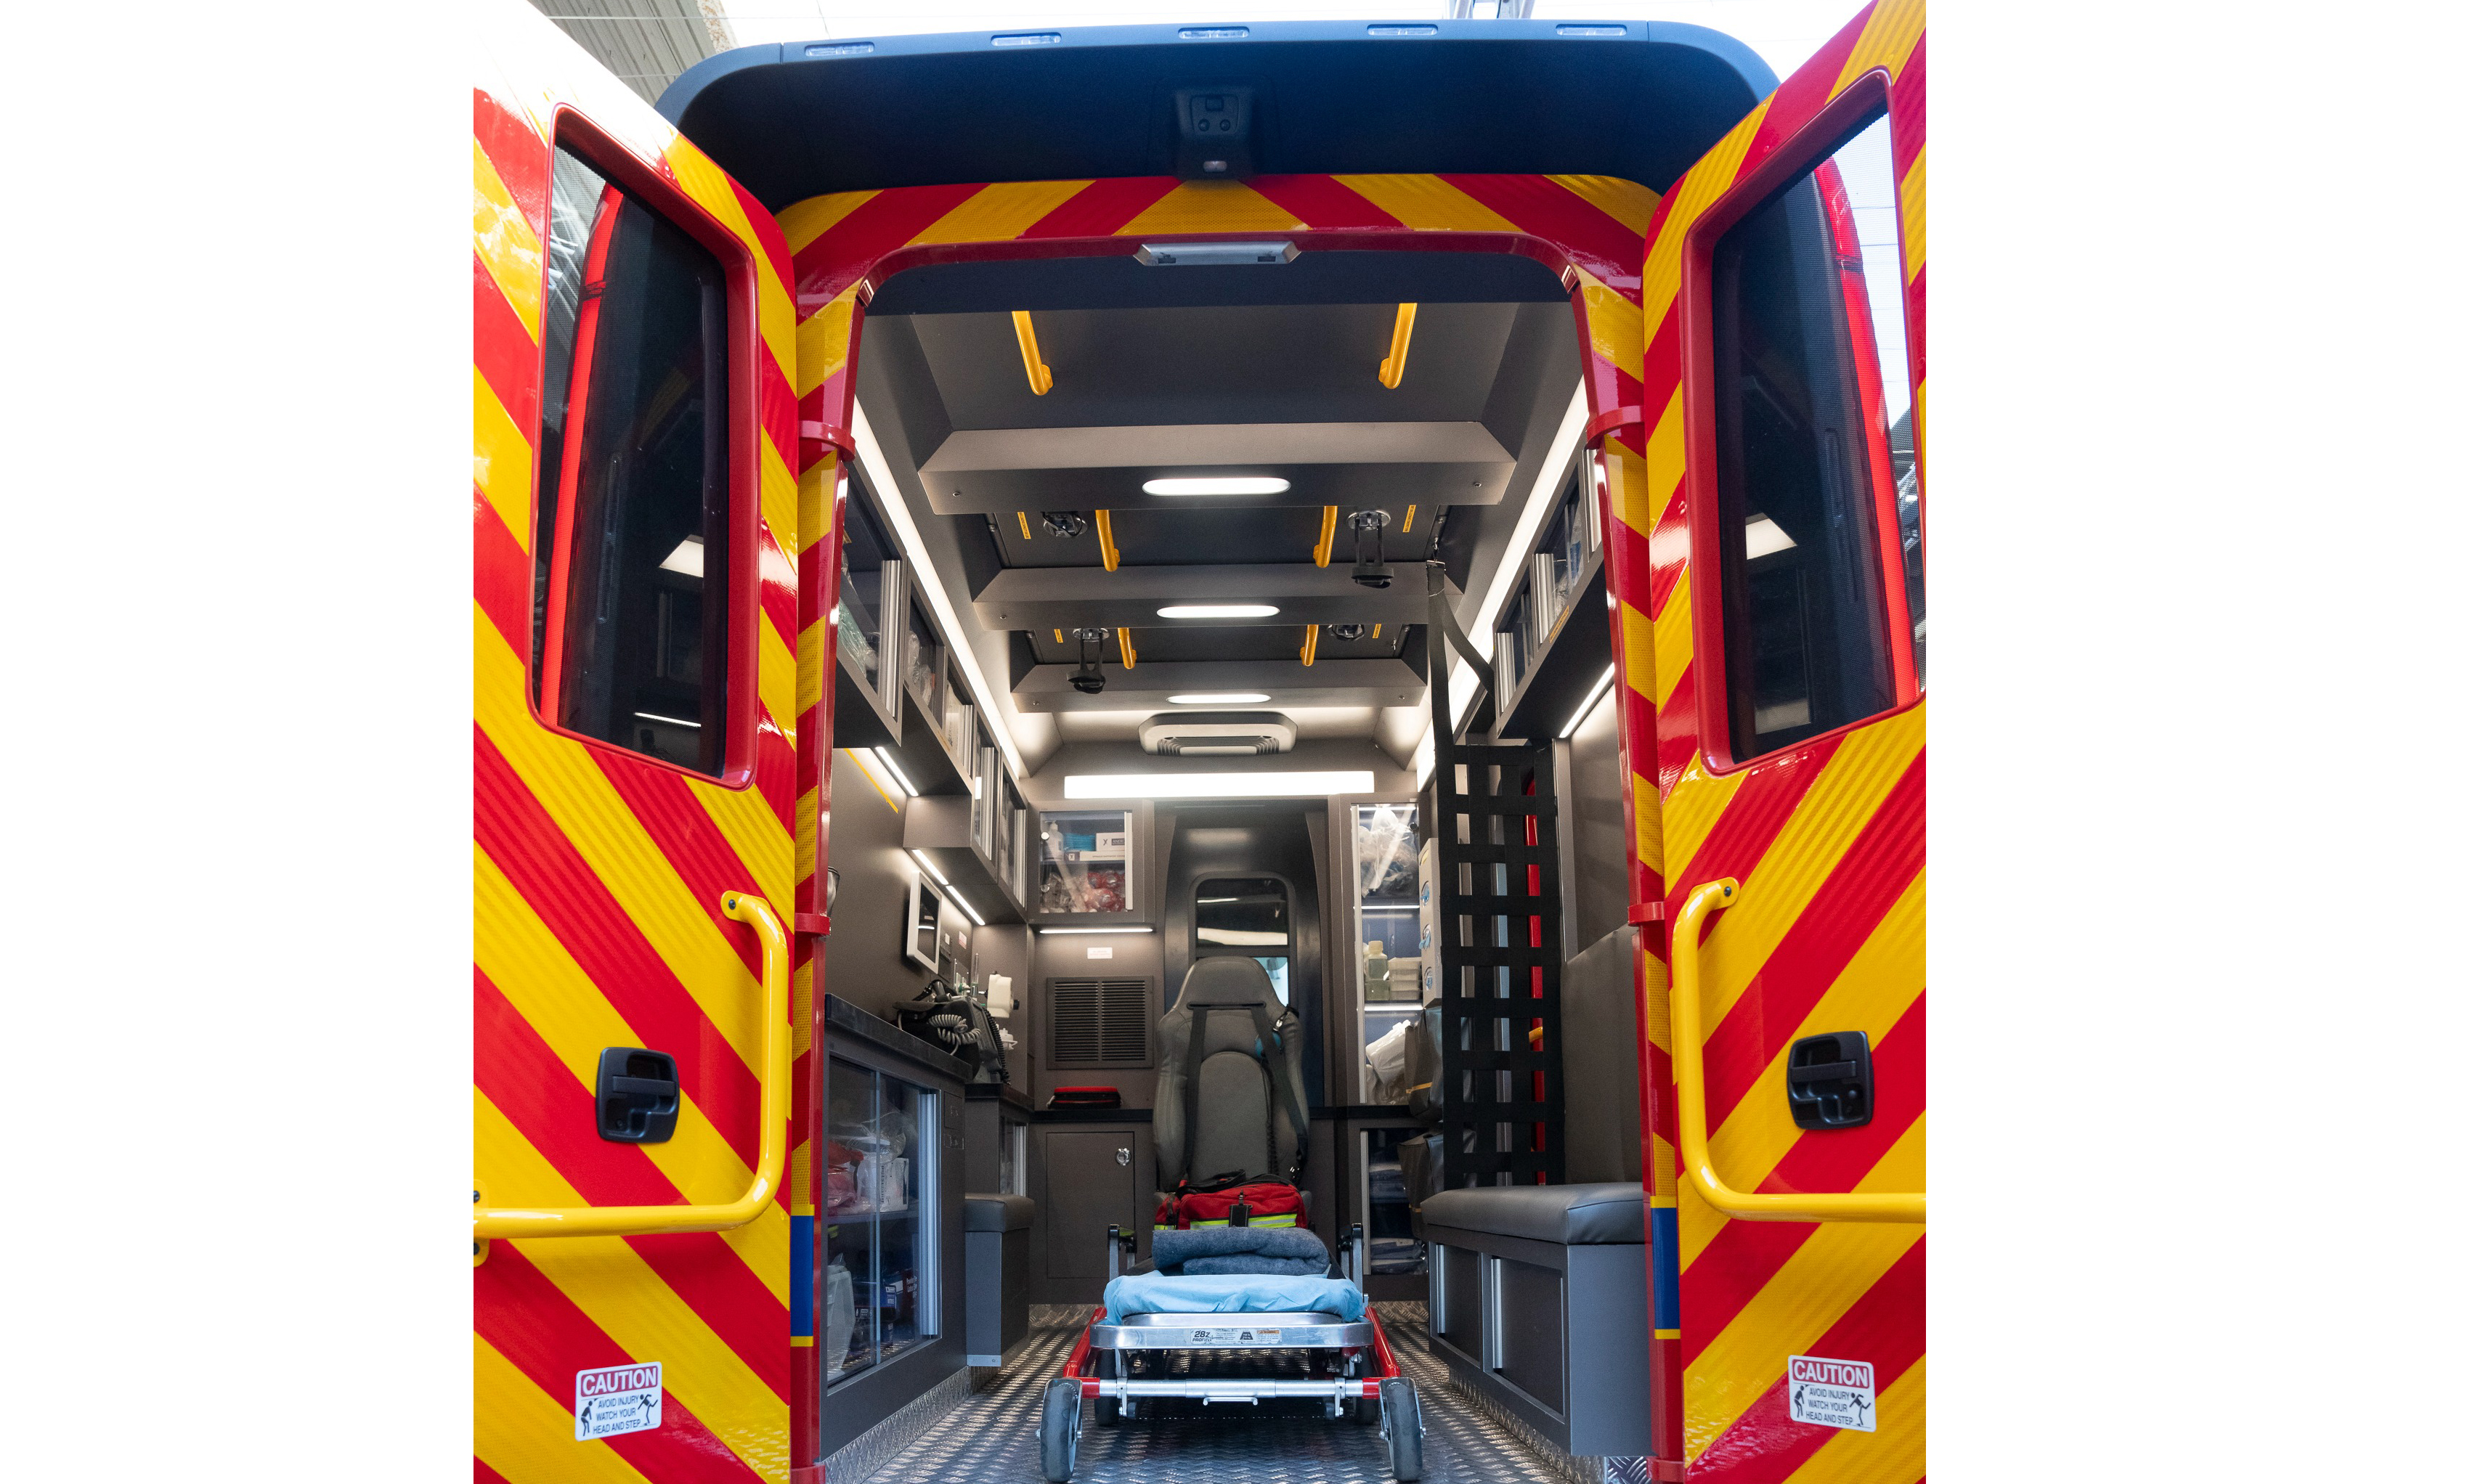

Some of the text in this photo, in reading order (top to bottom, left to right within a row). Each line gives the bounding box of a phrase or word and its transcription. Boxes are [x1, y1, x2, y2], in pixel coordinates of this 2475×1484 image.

[1794, 1361, 1868, 1387] CAUTION
[582, 1368, 657, 1395] CAUTION
[598, 1394, 640, 1408] AVOID INJURY
[1809, 1387, 1850, 1401] AVOID INJURY
[1808, 1399, 1848, 1412] WATCH YOUR
[596, 1408, 636, 1421] WATCH YOUR
[1805, 1411, 1853, 1425] HEAD AND STEP
[593, 1419, 641, 1435] HEAD AND STEP
